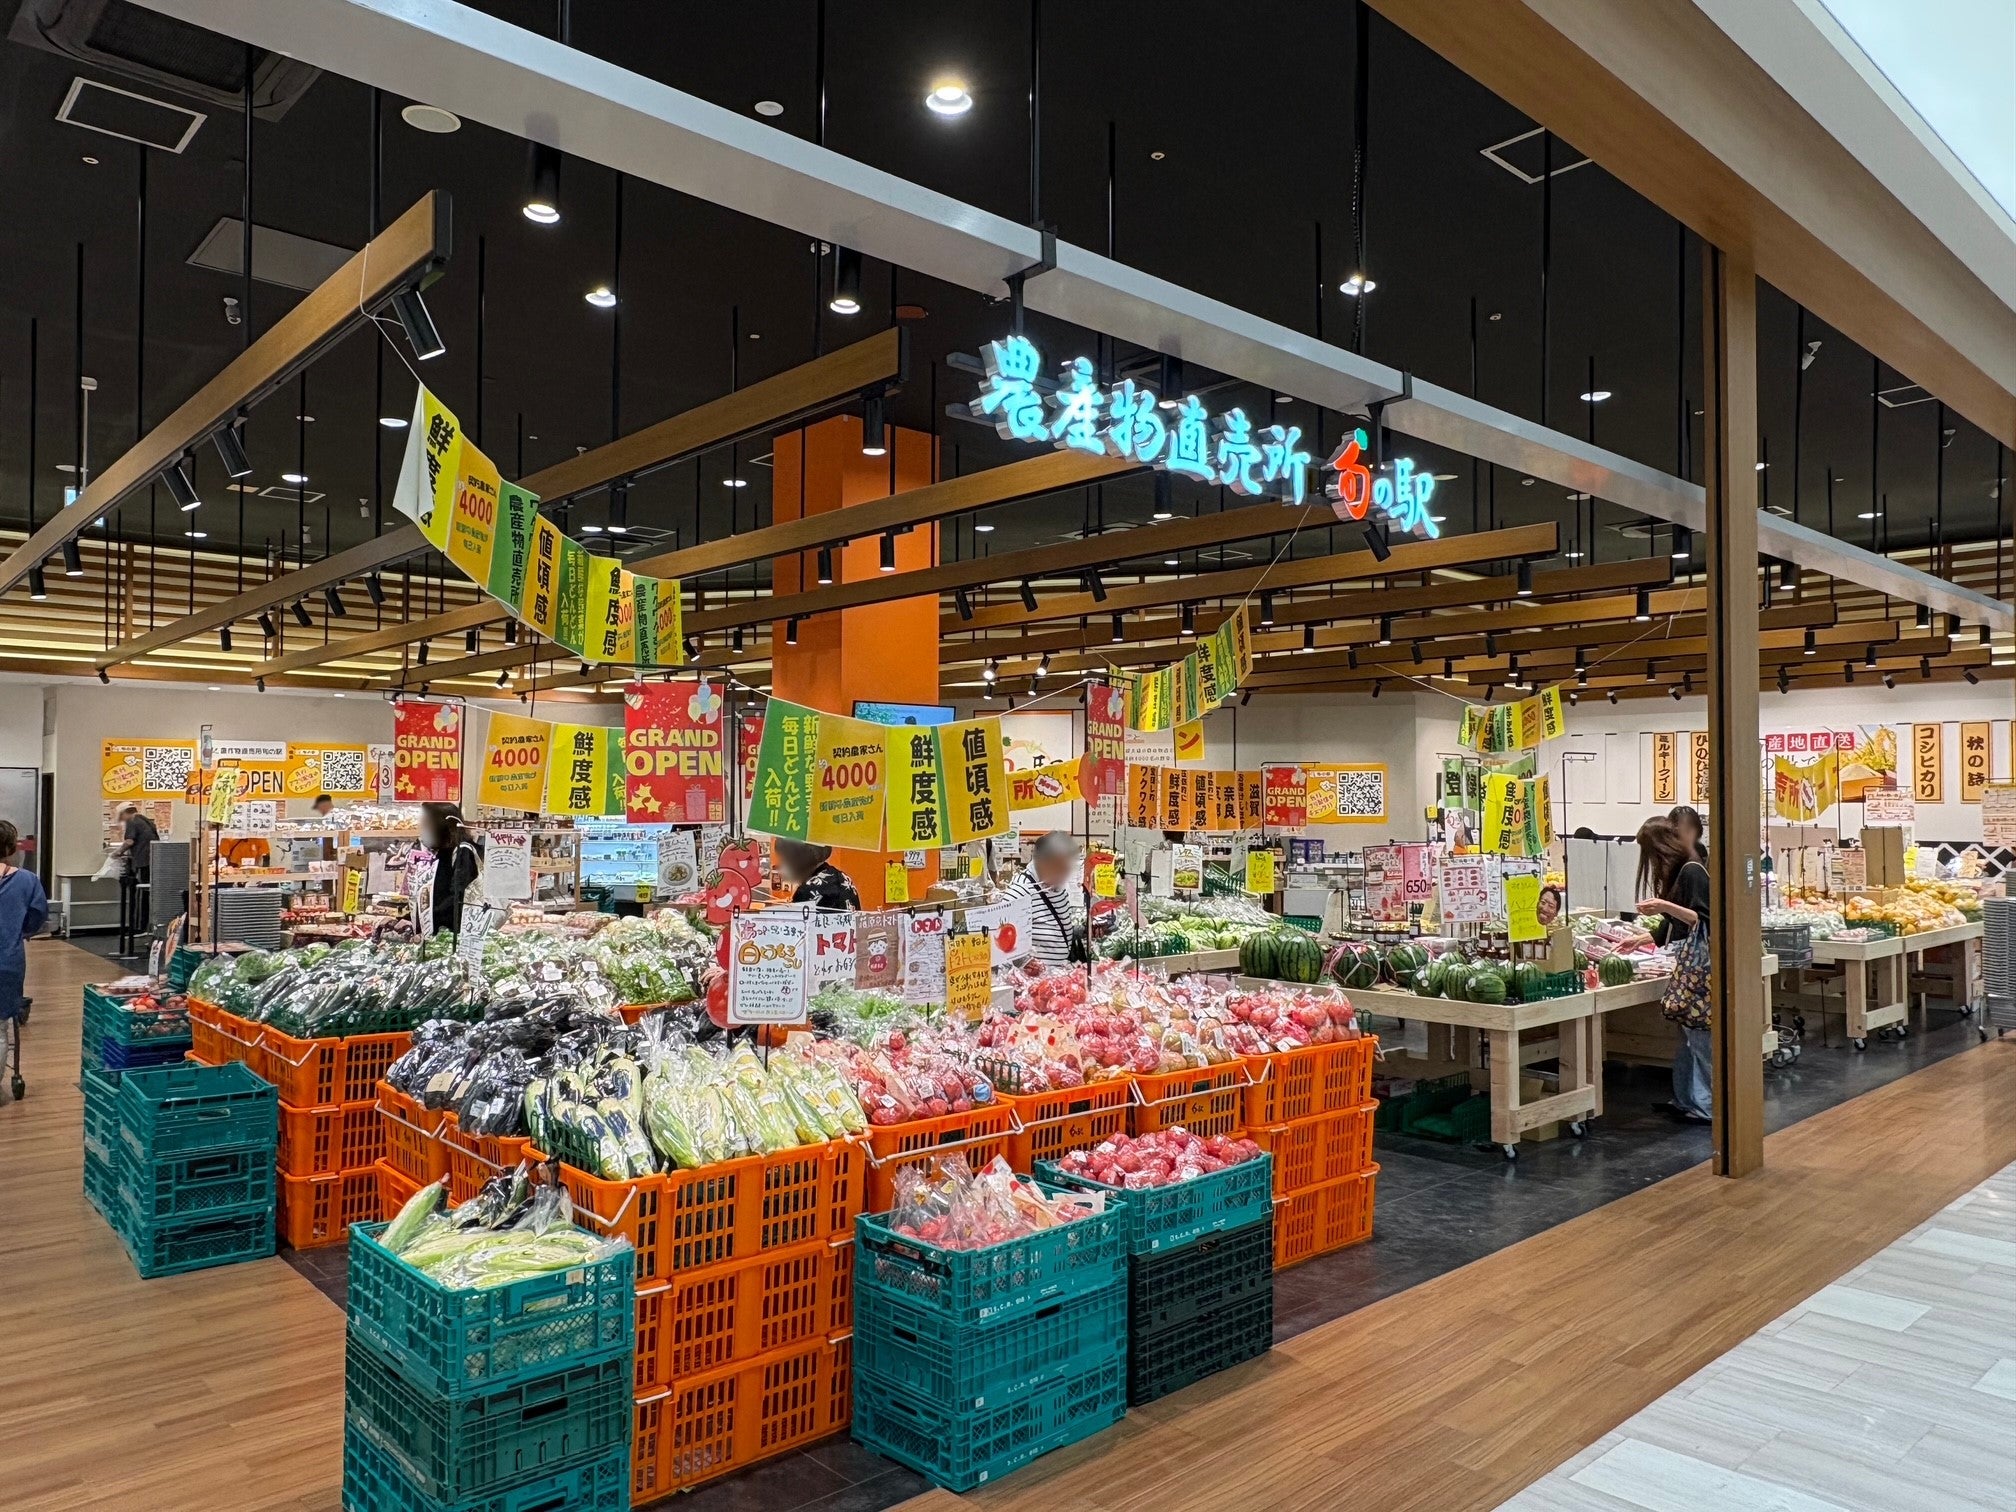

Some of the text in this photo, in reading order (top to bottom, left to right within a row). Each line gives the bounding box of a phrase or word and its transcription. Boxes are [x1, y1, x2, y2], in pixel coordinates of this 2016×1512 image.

[980, 334, 1440, 539] 農産物直売所 旬の駅
[459, 489, 493, 526] 4000
[510, 494, 524, 605] 農産物直売所
[534, 525, 554, 625] 値頃感
[396, 735, 457, 750] GRAND
[629, 728, 719, 747] GRAND
[832, 743, 884, 759] 契約農家さん
[1766, 732, 1853, 752] 産地直送
[394, 750, 459, 770] OPEN
[491, 746, 541, 768] 4000
[568, 730, 594, 810] 鮮度感
[626, 750, 722, 776] OPEN
[1658, 734, 1671, 799] ミルキークイーン
[1919, 727, 1936, 798] コシヒカリ
[1966, 735, 1986, 787] 秋の詩
[821, 760, 877, 792] 4000
[909, 734, 937, 842] 鮮度感
[962, 727, 995, 832] 値頃感
[1266, 787, 1306, 796] GRAND
[1167, 773, 1180, 826] 鮮度感
[1194, 774, 1207, 827] 値頃感
[1224, 785, 1237, 819] 奈良
[1249, 783, 1260, 817] 滋賀
[1265, 796, 1307, 808] OPEN
[816, 928, 857, 956] トマト
[912, 919, 942, 932] トマト
